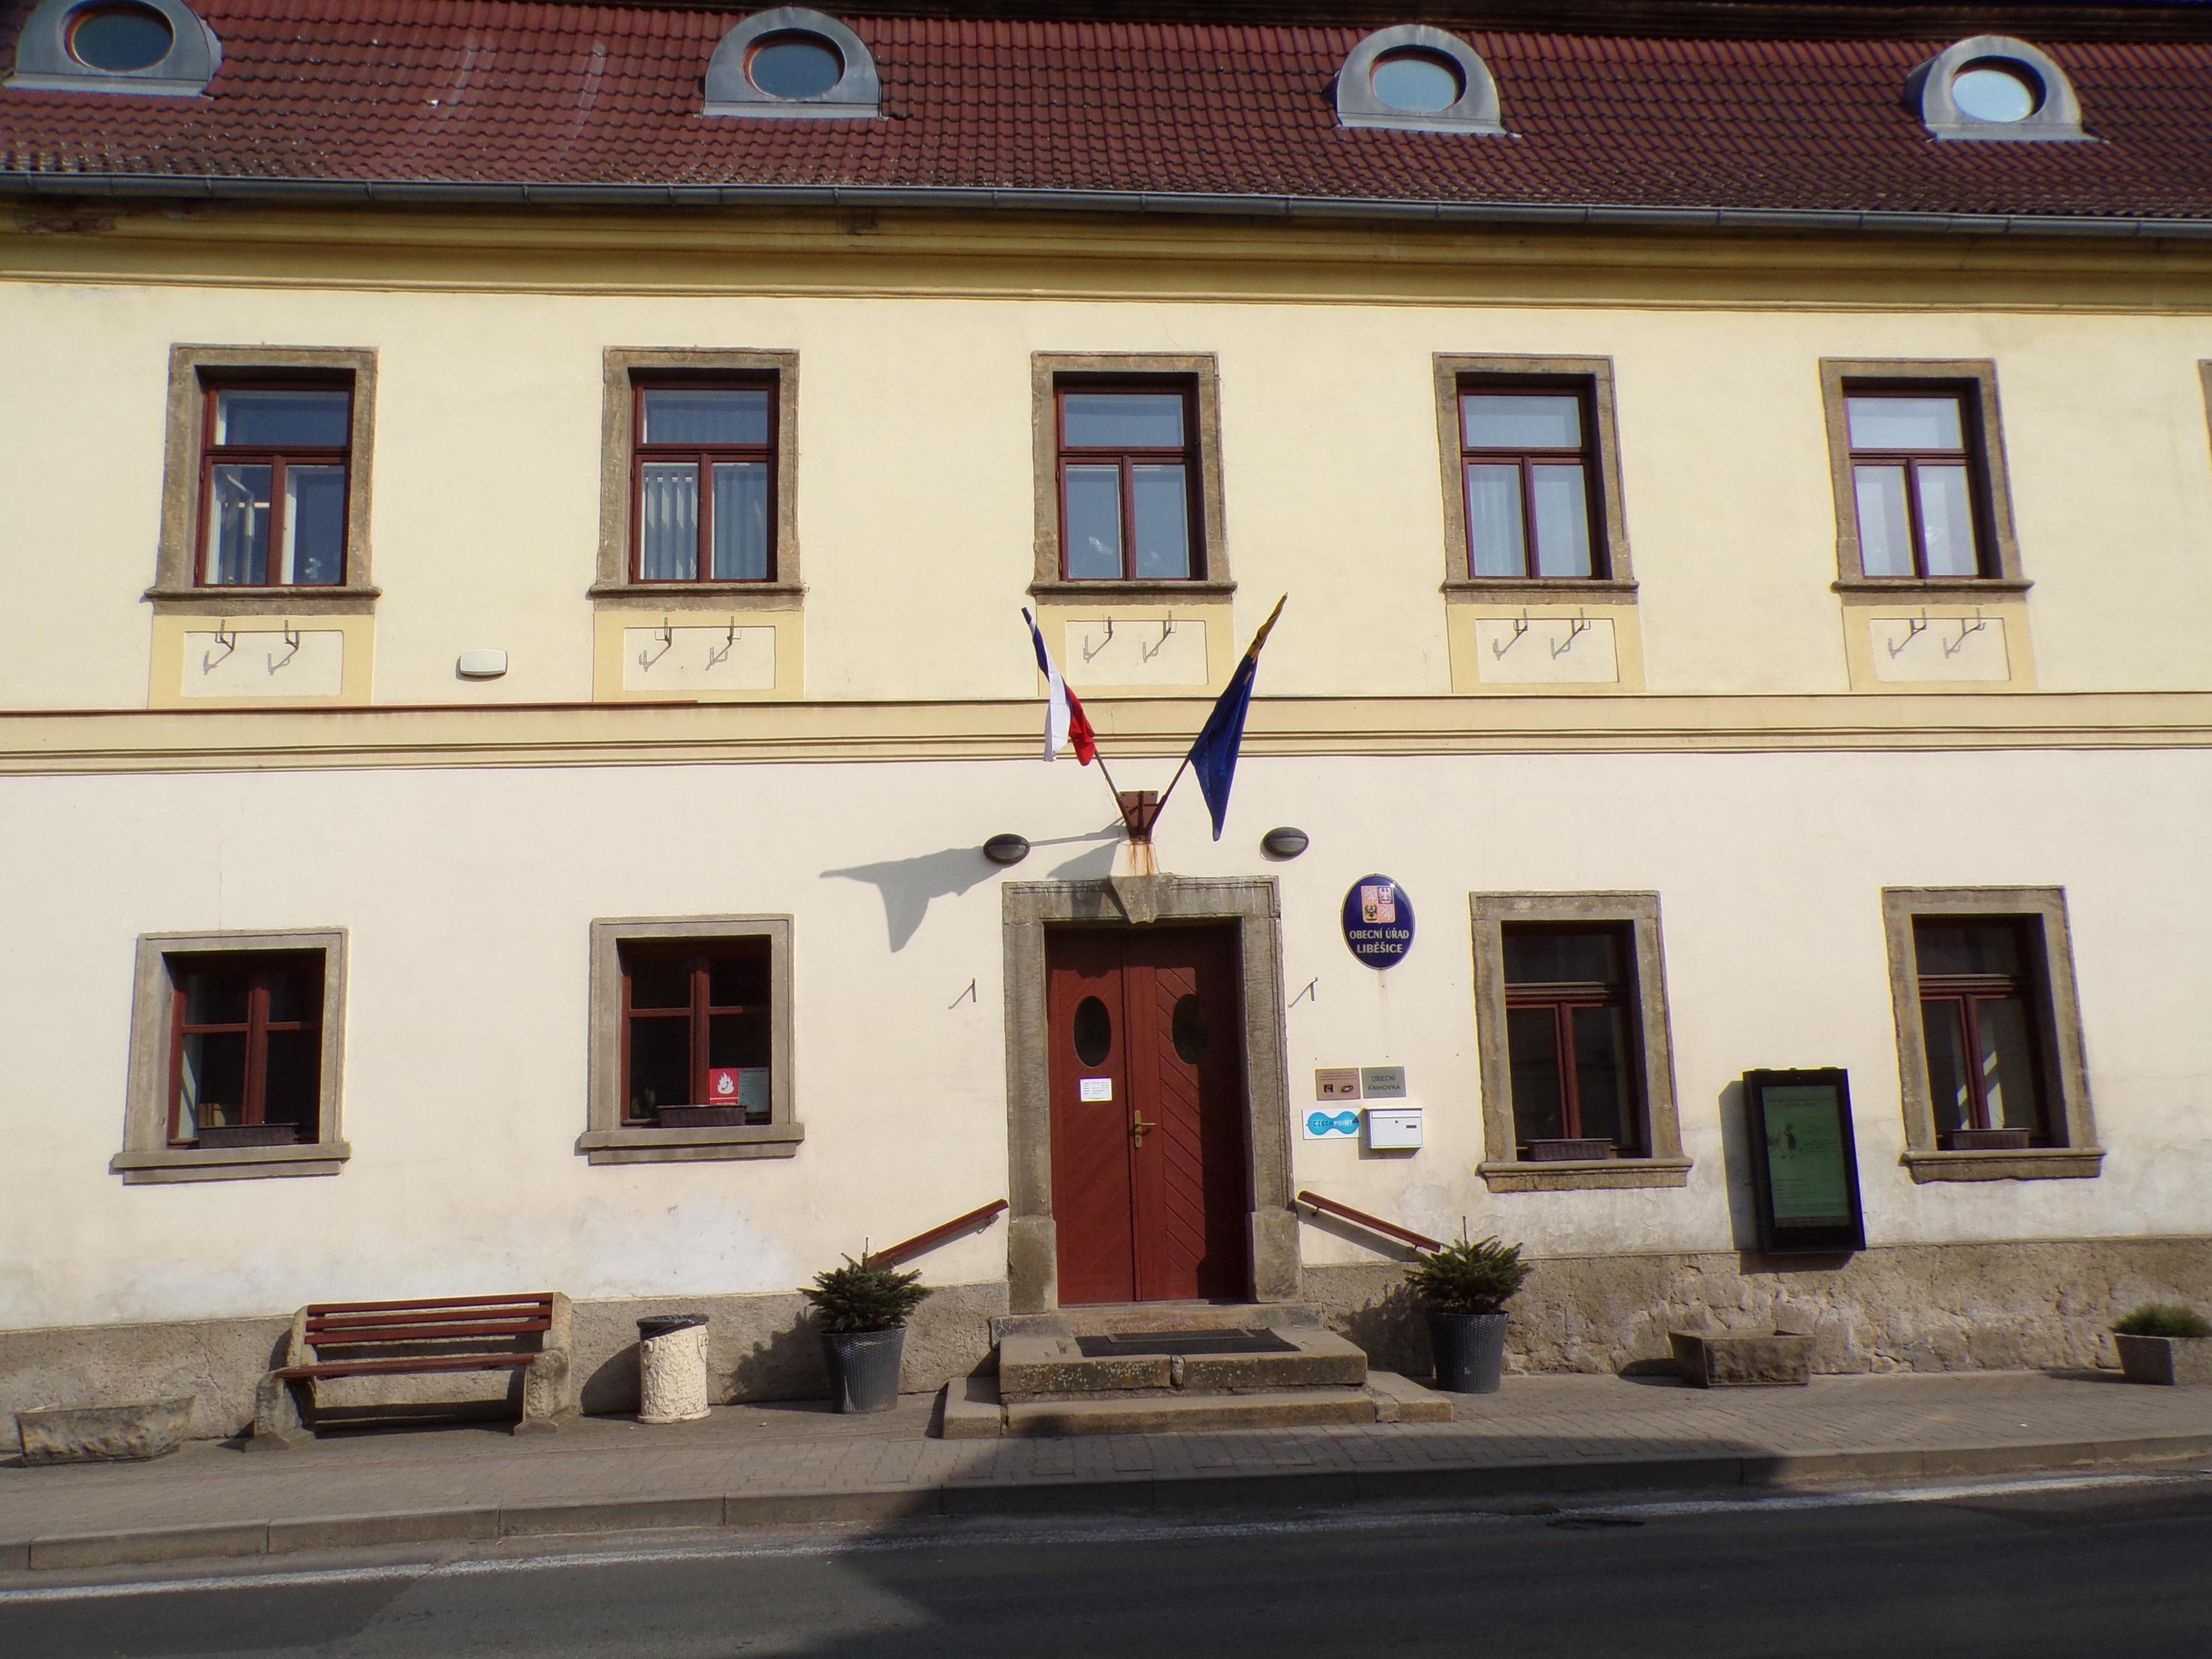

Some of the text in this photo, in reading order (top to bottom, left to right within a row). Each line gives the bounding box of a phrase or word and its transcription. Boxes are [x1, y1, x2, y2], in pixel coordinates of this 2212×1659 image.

[1349, 927, 1409, 939] OBECNÍ ÚŘAD
[1357, 941, 1402, 953] LIBĚŠICE
